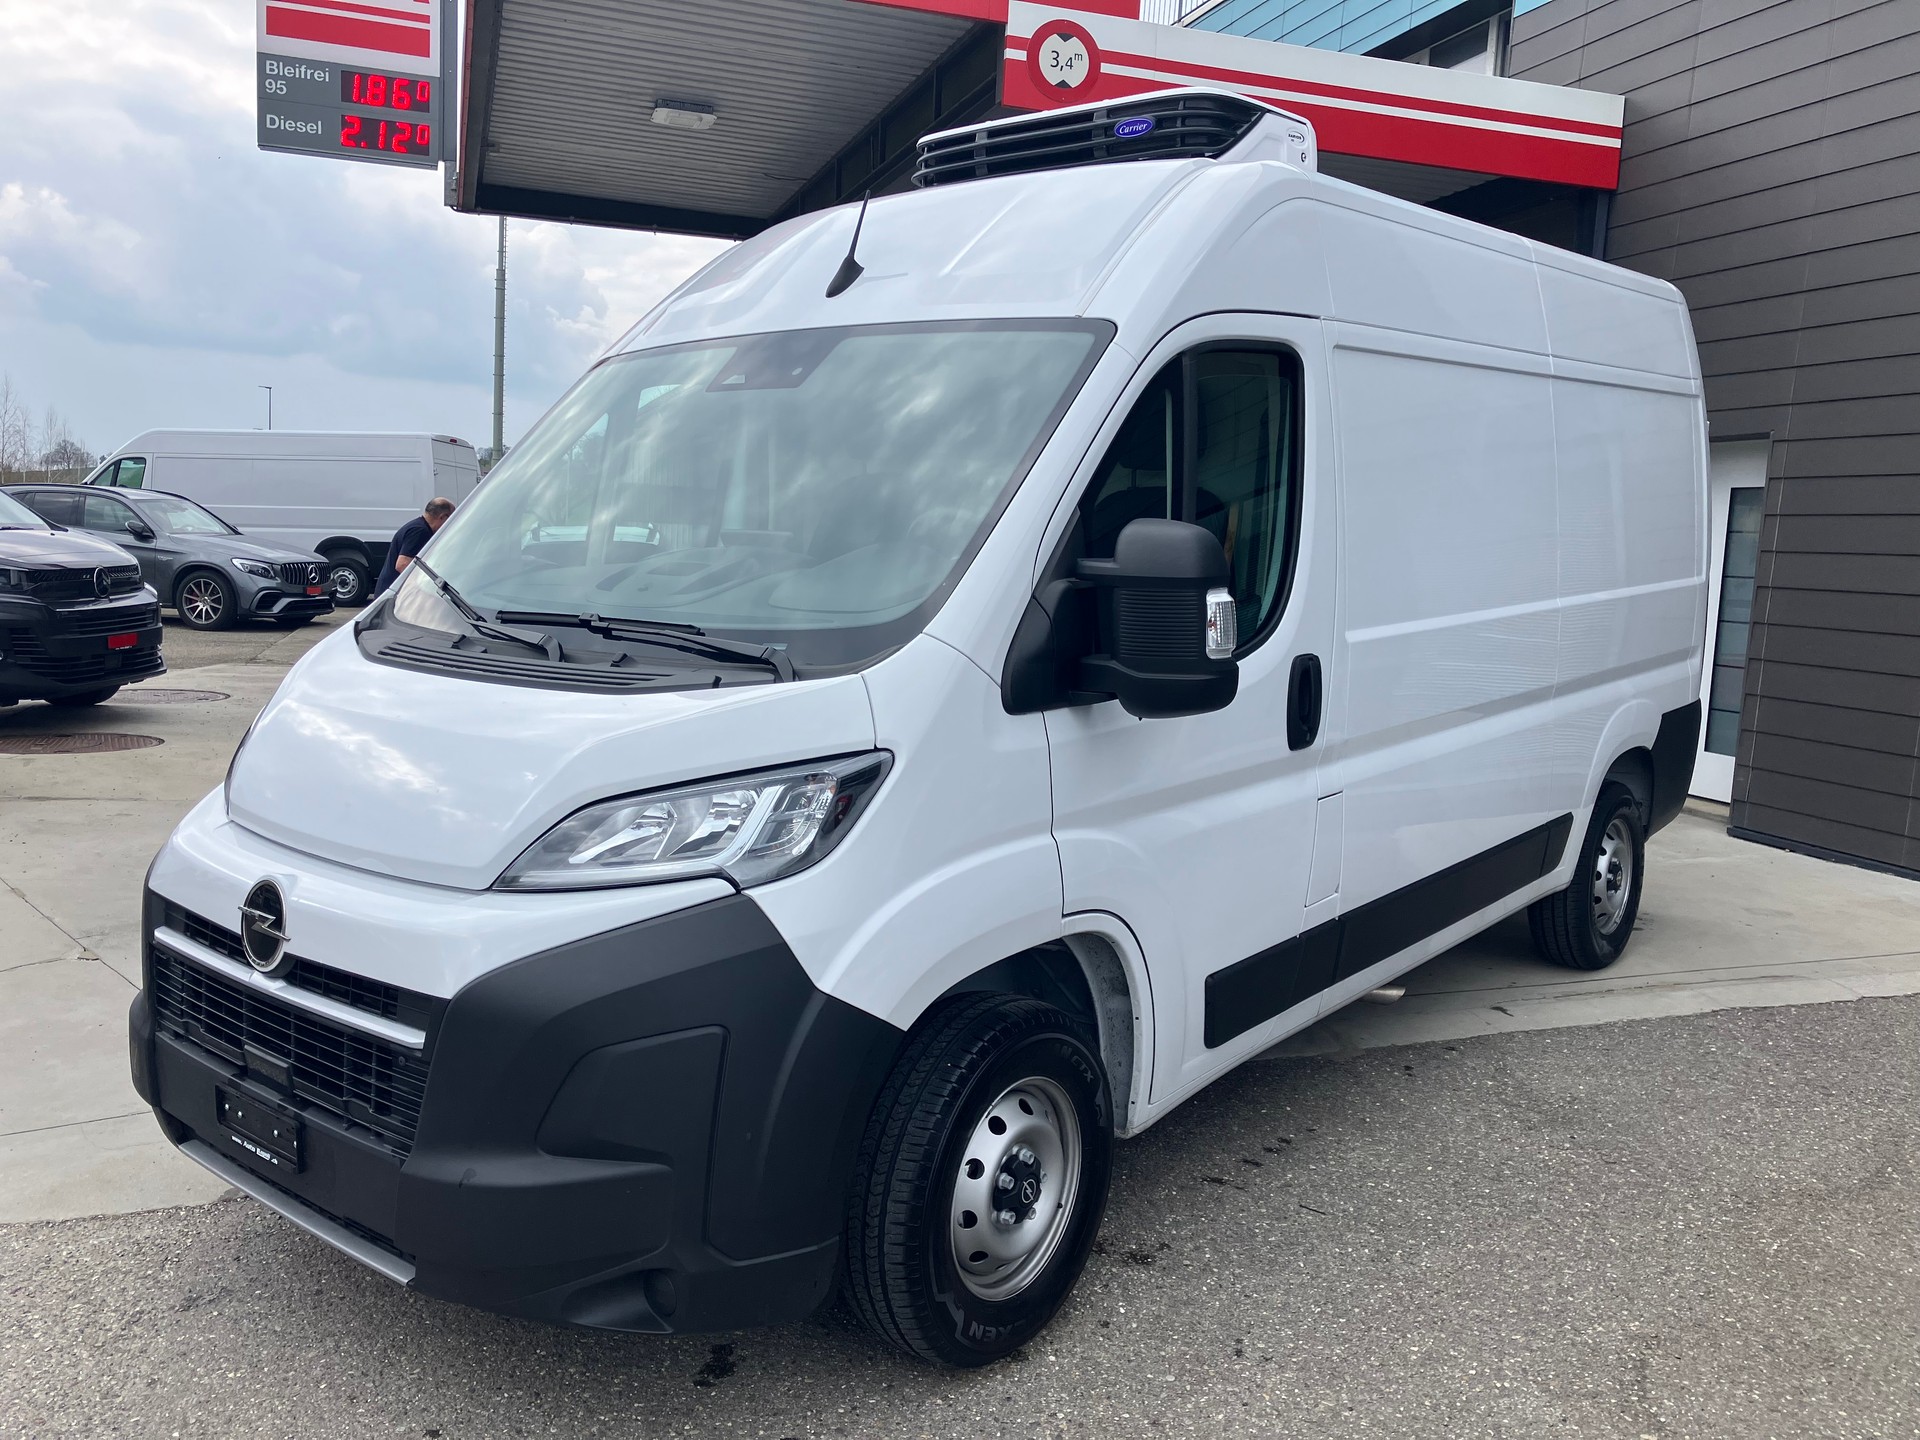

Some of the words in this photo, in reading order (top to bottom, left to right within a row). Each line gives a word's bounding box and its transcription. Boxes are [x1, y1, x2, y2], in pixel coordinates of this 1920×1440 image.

[265, 60, 330, 82] Bleifrei
[265, 79, 287, 95] 95
[266, 114, 322, 135] Diesel
[1119, 122, 1148, 134] Carrier
